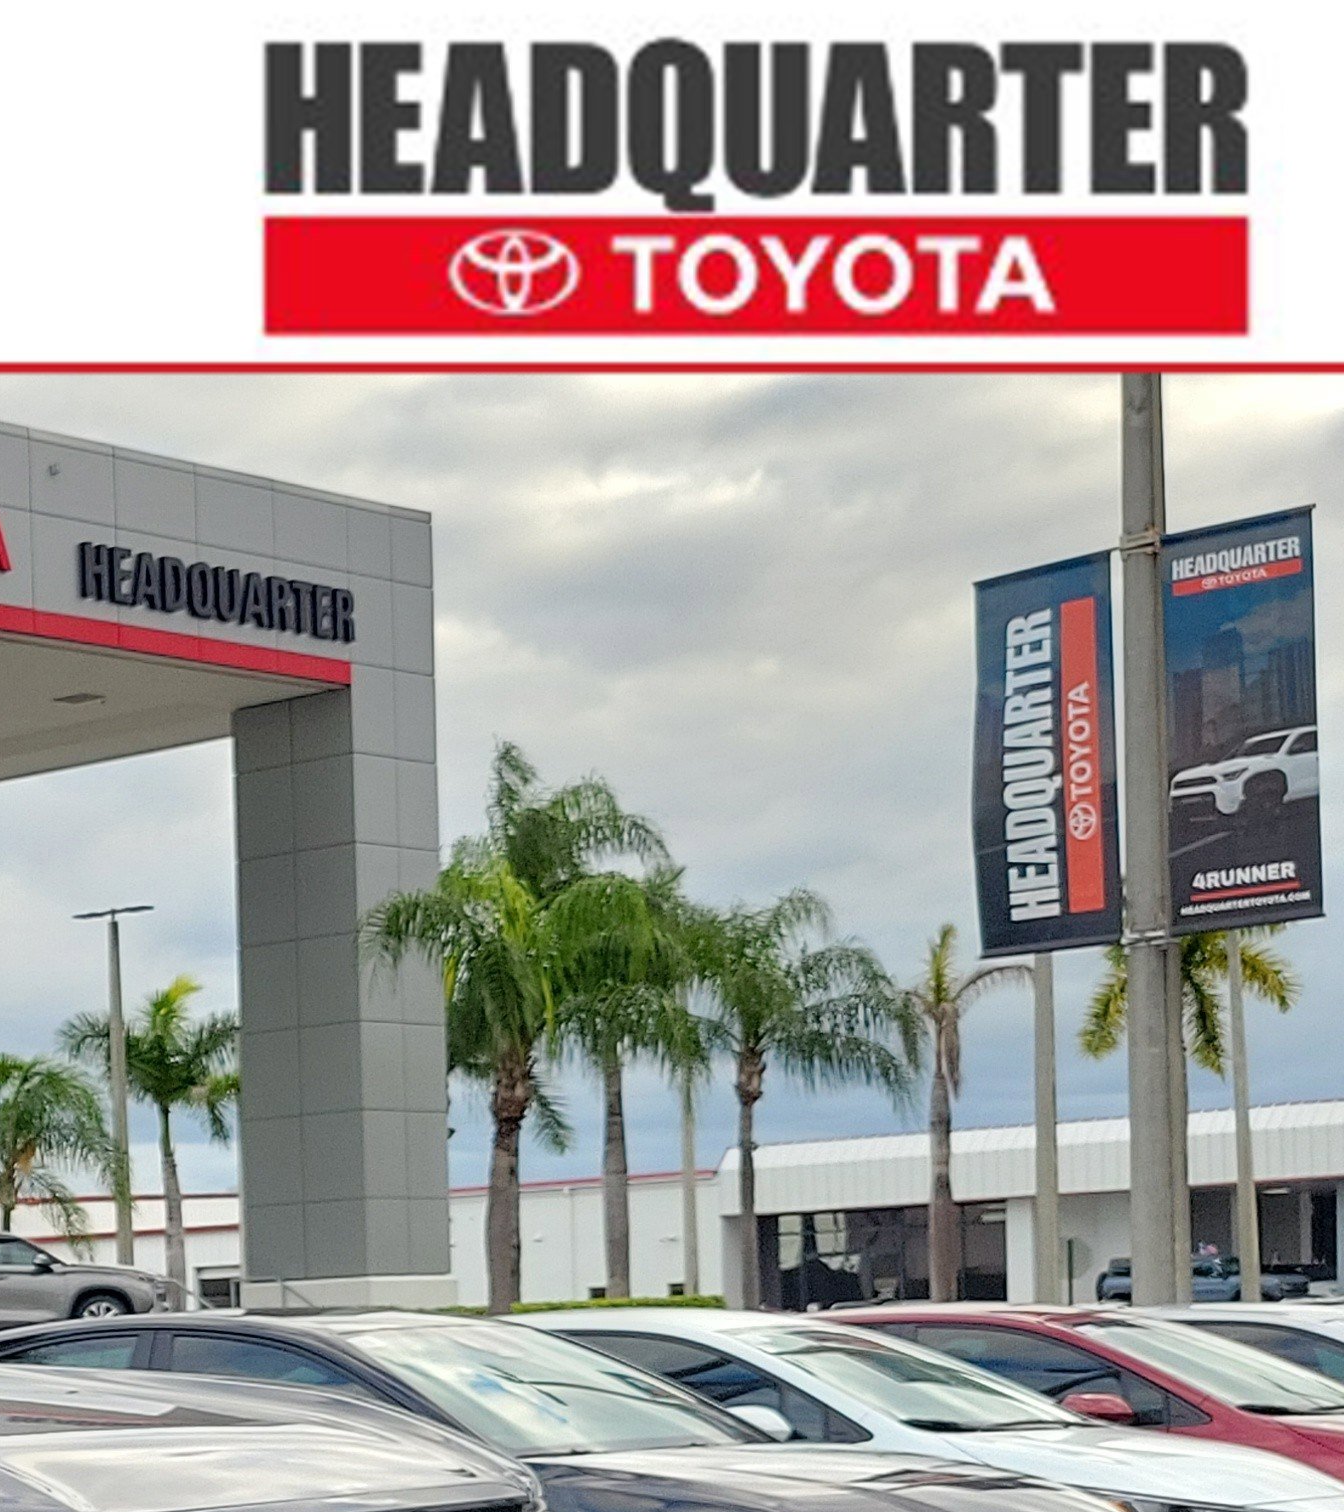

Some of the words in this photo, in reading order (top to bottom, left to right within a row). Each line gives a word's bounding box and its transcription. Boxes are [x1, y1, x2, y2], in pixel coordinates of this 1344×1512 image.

[79, 542, 356, 643] HEADQUARTER
[1171, 537, 1301, 580] HEADQUARTER
[1218, 568, 1268, 586] TOYOTA
[1003, 608, 1062, 922] HEADQUARTER
[1067, 681, 1092, 809] TOYOTA
[1192, 861, 1296, 890] 4RUNNER
